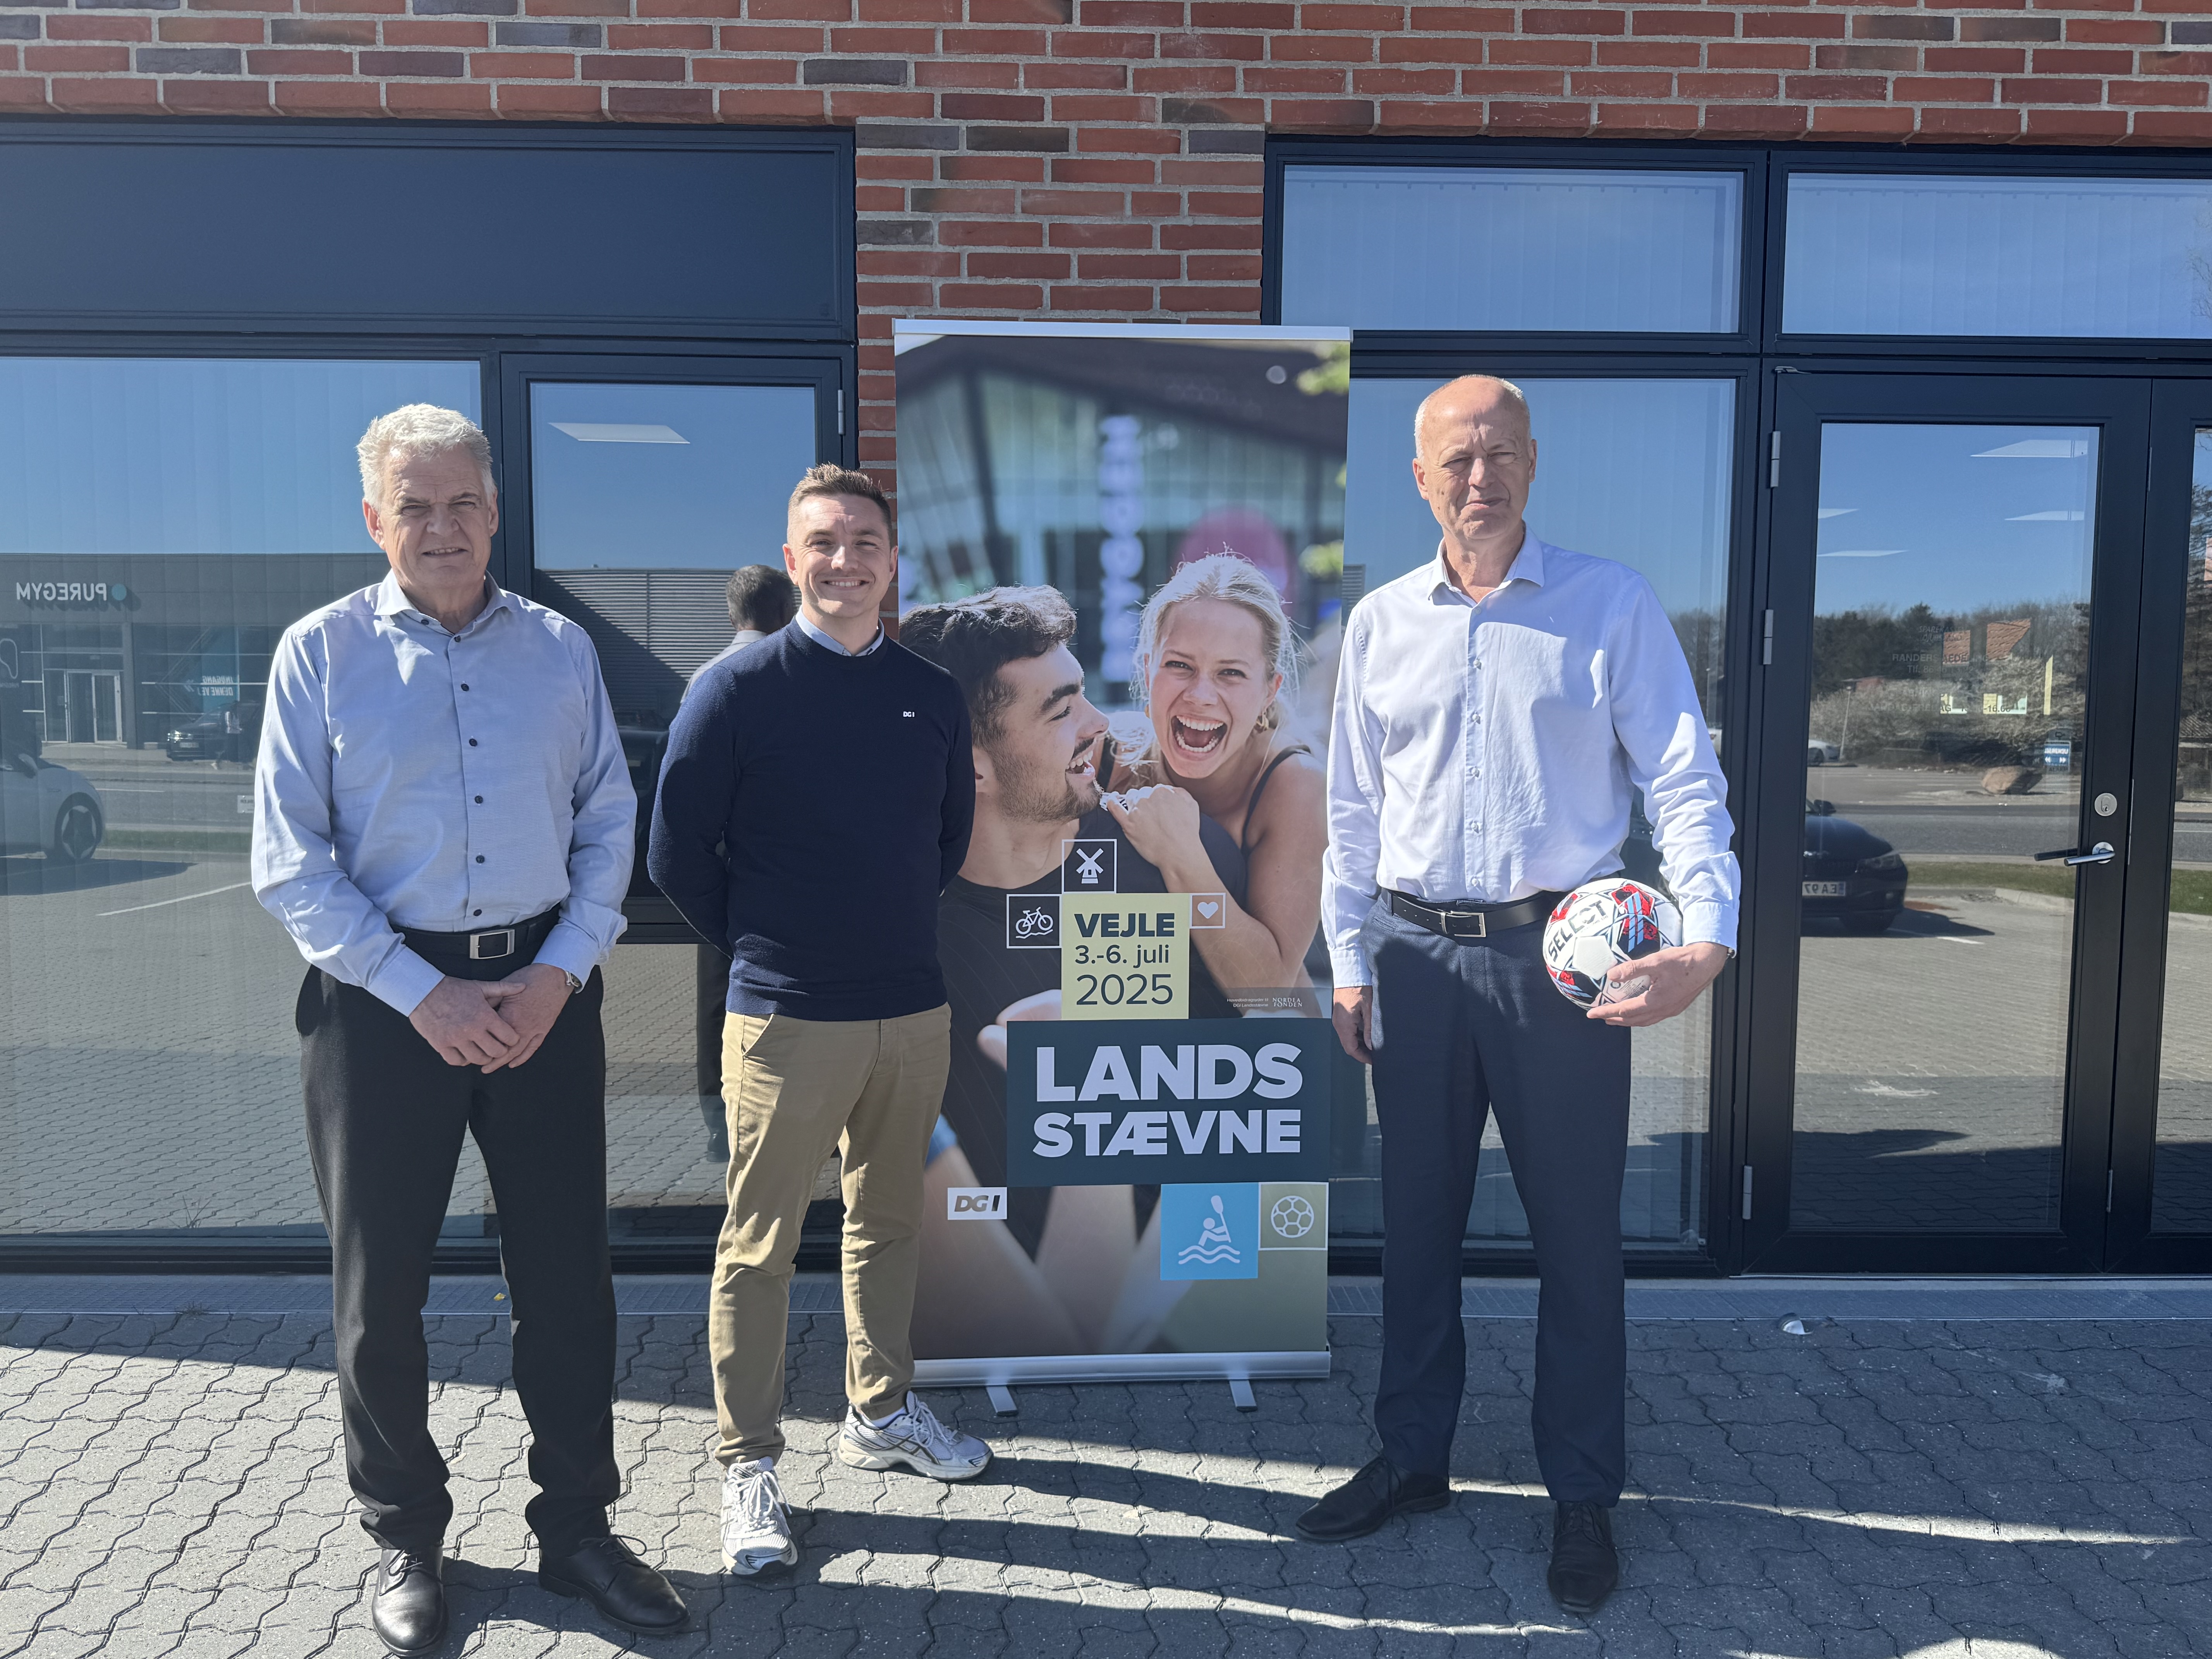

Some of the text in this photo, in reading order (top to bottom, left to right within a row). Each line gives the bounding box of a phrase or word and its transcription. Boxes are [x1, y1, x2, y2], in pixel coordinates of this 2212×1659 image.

[1892, 654, 1939, 662] RANDERS
[1907, 665, 1921, 673] Tlf.
[1923, 665, 1934, 673] 86
[1074, 913, 1175, 938] VEJLE
[1075, 944, 1169, 969] 3.-6. juli
[1077, 974, 1173, 1005] 2025
[1037, 1043, 1303, 1102] LANDS
[1032, 1109, 1301, 1158] STÆVNE
[954, 1195, 1001, 1212] DGI
